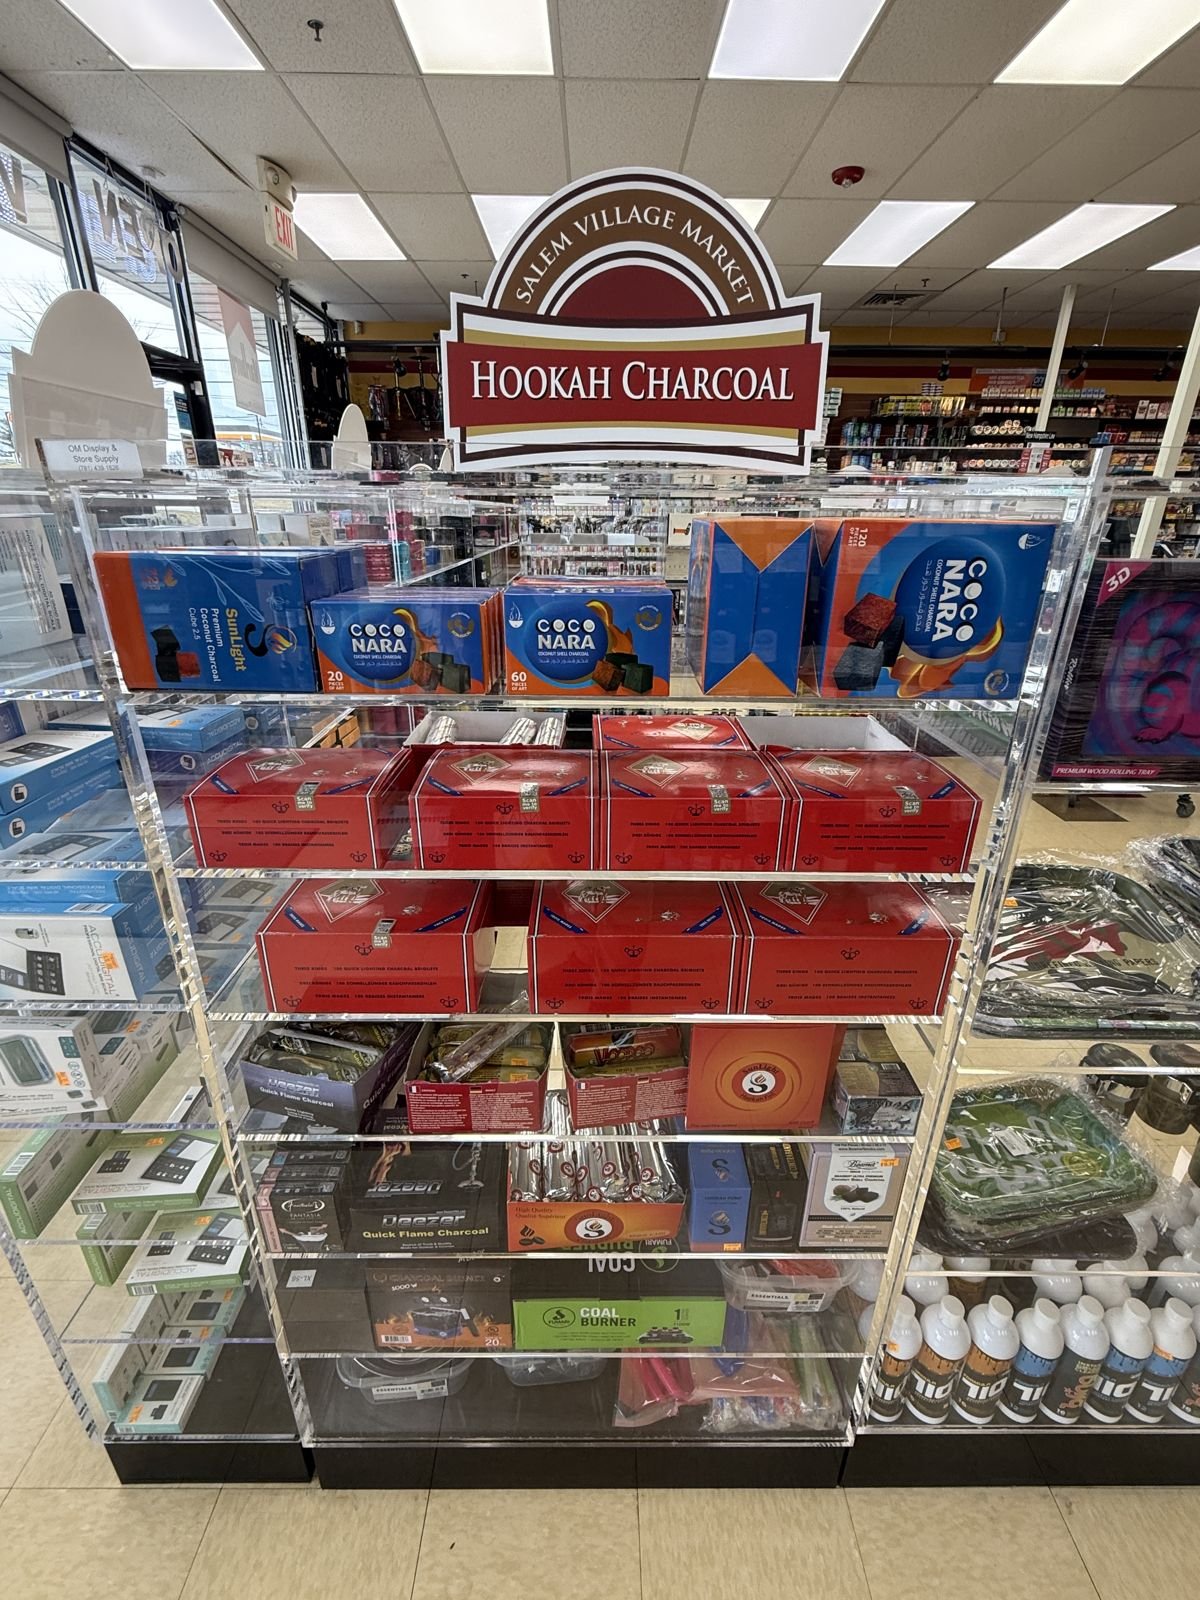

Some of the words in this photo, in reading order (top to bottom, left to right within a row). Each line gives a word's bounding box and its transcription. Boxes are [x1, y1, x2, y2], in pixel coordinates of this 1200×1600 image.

[275, 207, 294, 250] EXIT
[515, 230, 573, 305] SALEM
[574, 205, 676, 236] VILLAGE
[680, 218, 755, 305] MARKET
[83, 444, 110, 454] Display
[73, 455, 92, 463] Store
[94, 454, 119, 464] Supply
[858, 528, 868, 547] 120
[934, 559, 944, 586] COCONUT
[1106, 566, 1132, 592] 3D
[930, 587, 938, 603] SHELL
[932, 560, 967, 642] NARA
[955, 560, 987, 642] COCO
[188, 608, 198, 627] Cube
[538, 619, 596, 632] COCO
[924, 604, 934, 632] CHARCOAL
[210, 608, 224, 647] Premium
[350, 624, 405, 637] COCO
[200, 608, 214, 643] Coconut
[207, 645, 221, 682] Charcoal
[225, 608, 247, 672] SunLight
[352, 639, 408, 653] NARA
[538, 634, 596, 650] NARA
[327, 671, 343, 681] 20
[511, 672, 527, 682] 60
[1056, 767, 1086, 775] PREMIUM
[1087, 767, 1109, 775] WOOD
[1109, 767, 1137, 776] ROLLING
[1138, 768, 1156, 776] TRAY
[259, 1086, 279, 1097] Quick
[280, 1091, 300, 1101] Flame
[302, 1096, 334, 1108] Charcoal
[362, 1231, 396, 1239] Quick
[438, 1228, 489, 1236] Charcoal
[580, 1307, 620, 1318] COAL
[674, 1308, 681, 1320] 1
[581, 1318, 636, 1327] BURNER
